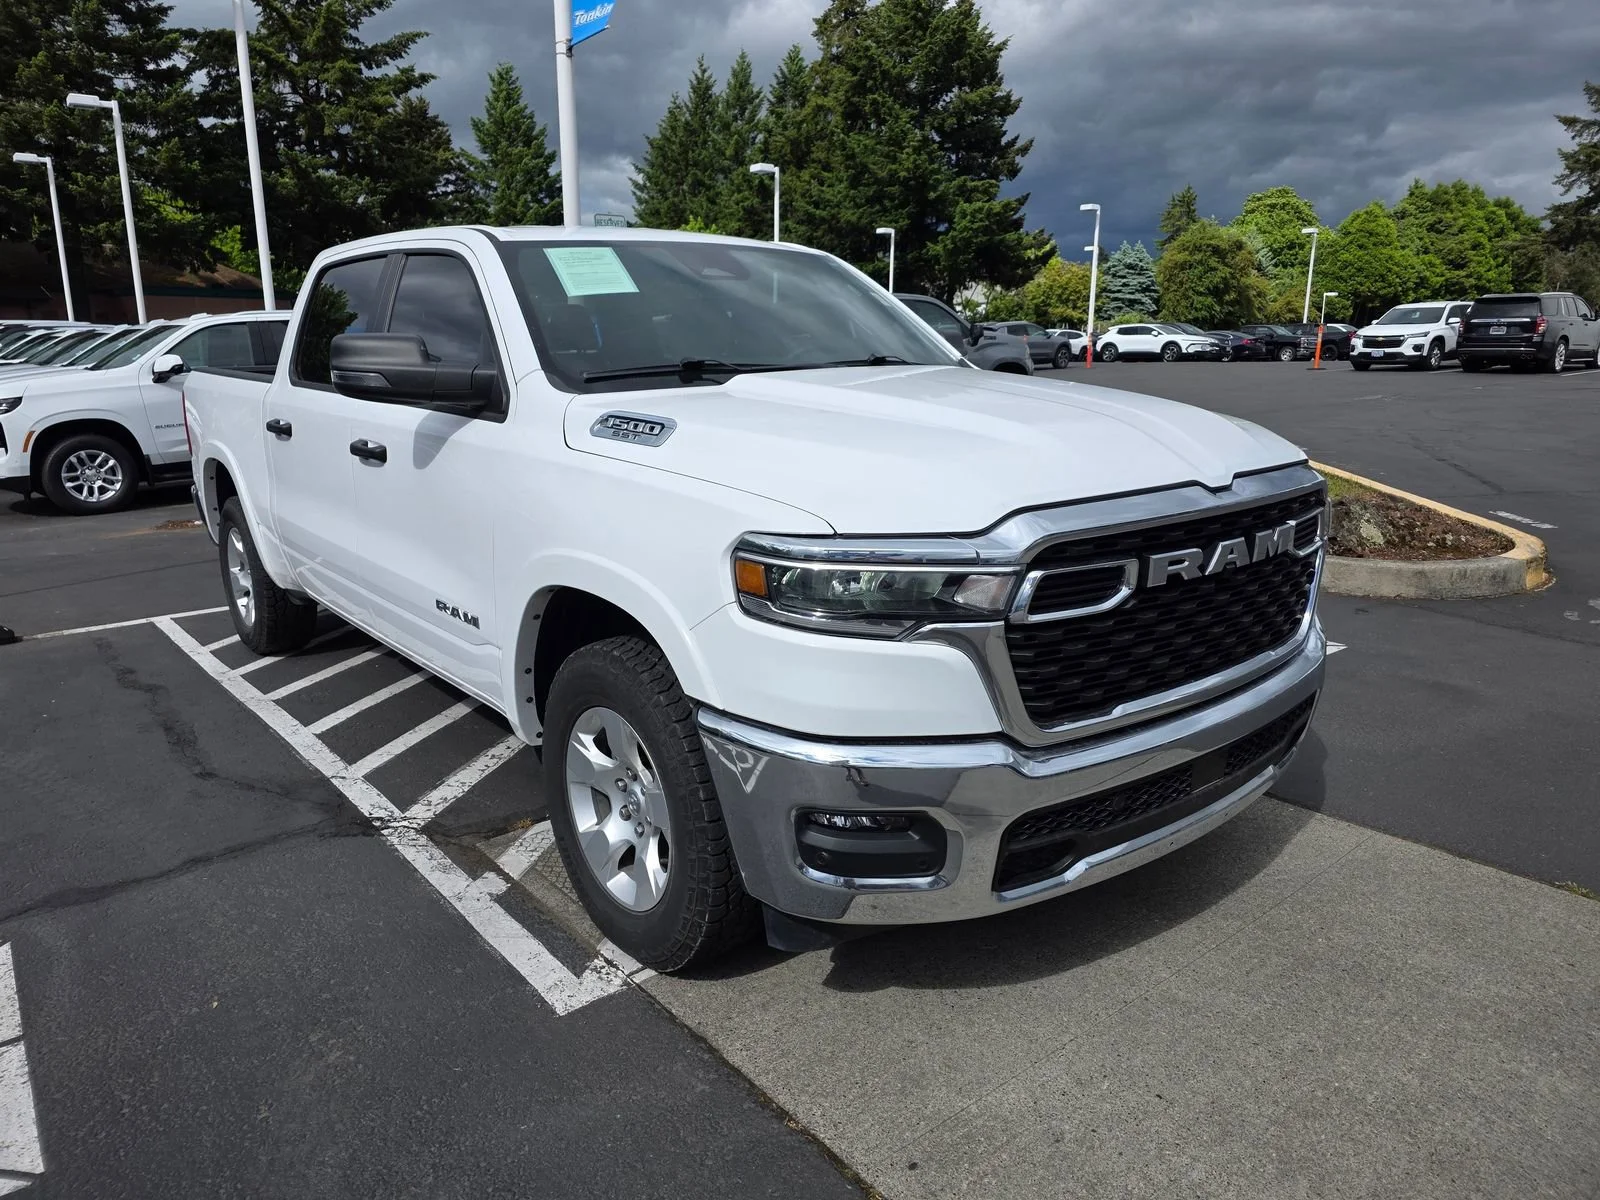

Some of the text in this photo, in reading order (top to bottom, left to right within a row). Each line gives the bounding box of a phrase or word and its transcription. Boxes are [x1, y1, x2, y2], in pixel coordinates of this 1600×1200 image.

[575, 3, 614, 25] Tonkin
[604, 417, 662, 435] 1500
[611, 430, 642, 441] SST
[1147, 521, 1296, 588] RAM
[436, 599, 481, 630] RAM
